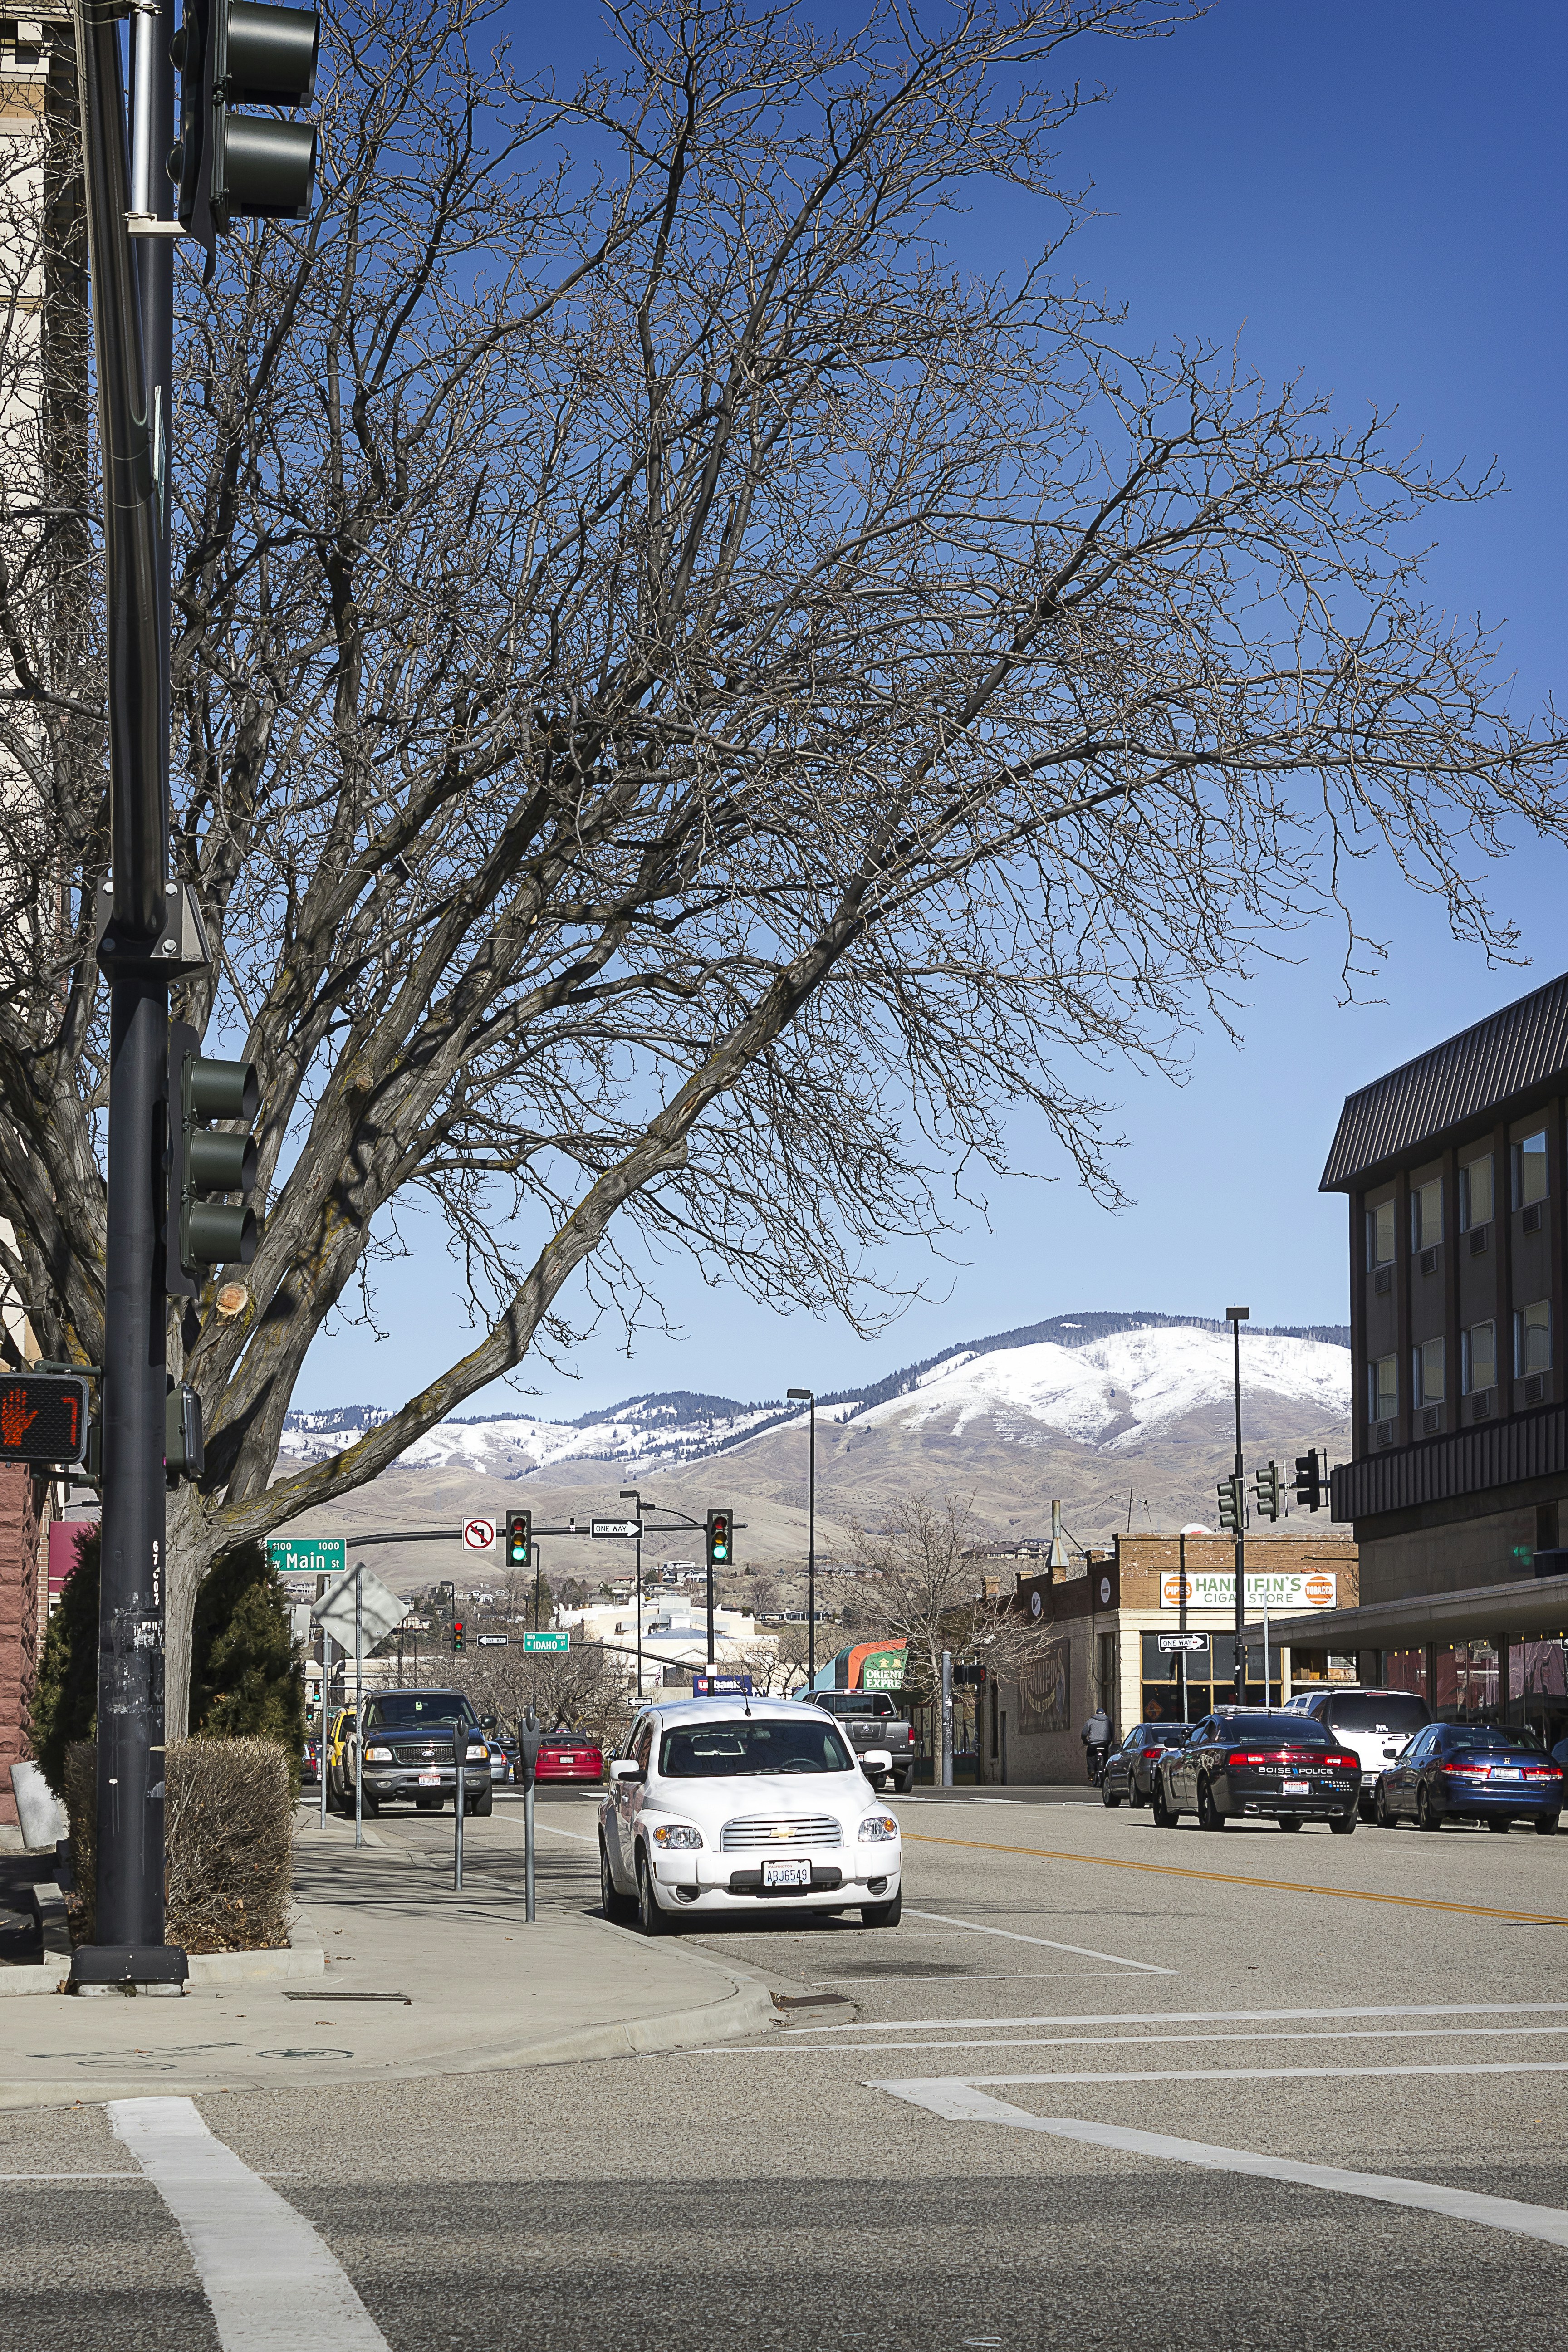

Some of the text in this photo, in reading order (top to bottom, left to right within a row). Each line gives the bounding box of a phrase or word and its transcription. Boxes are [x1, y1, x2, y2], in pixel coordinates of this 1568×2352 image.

[318, 1542, 339, 1550] 1000
[286, 1552, 325, 1568] Main
[1196, 1576, 1301, 1592] HANIFIN'S
[1166, 1585, 1191, 1595] PIPES
[1306, 1585, 1333, 1595] TOBACCO
[1204, 1593, 1293, 1603] CIGA STORE
[533, 1641, 557, 1650] IDAHO
[714, 1680, 741, 1689] bank
[767, 1869, 807, 1882] ABJ6549
[156, 2042, 244, 2052] DOWN
